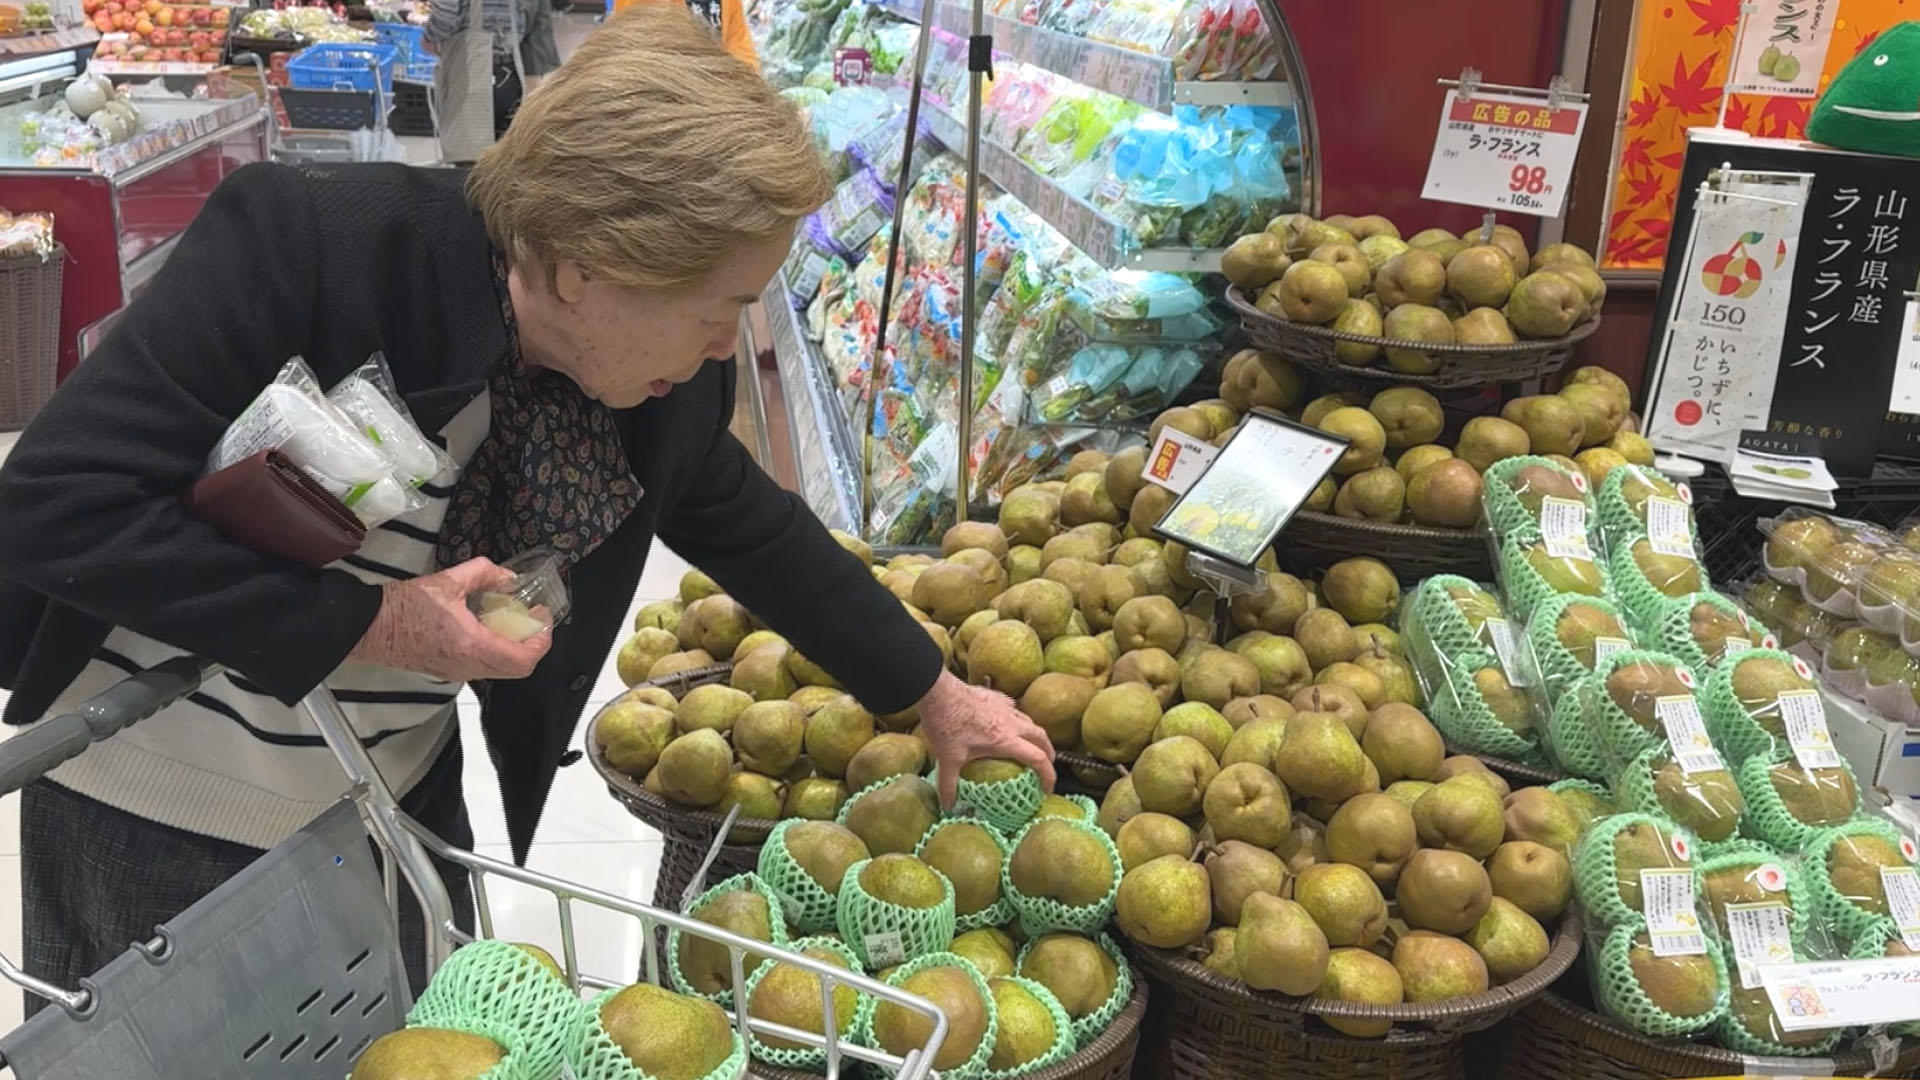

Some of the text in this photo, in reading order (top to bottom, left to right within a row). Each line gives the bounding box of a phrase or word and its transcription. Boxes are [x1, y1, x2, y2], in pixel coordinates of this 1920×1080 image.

[1768, 0, 1808, 43] ンス
[1472, 102, 1552, 129] 広告の品
[1469, 134, 1542, 158] ラ・フランス
[1848, 189, 1908, 324] 山形県産
[1790, 187, 1862, 370] ラ・フランス
[1701, 302, 1746, 325] 150
[1687, 336, 1714, 397] かじつ。
[1706, 340, 1736, 426] いちずに、
[1743, 438, 1789, 450] AGATA
[1772, 420, 1843, 439] 芳醇な香り
